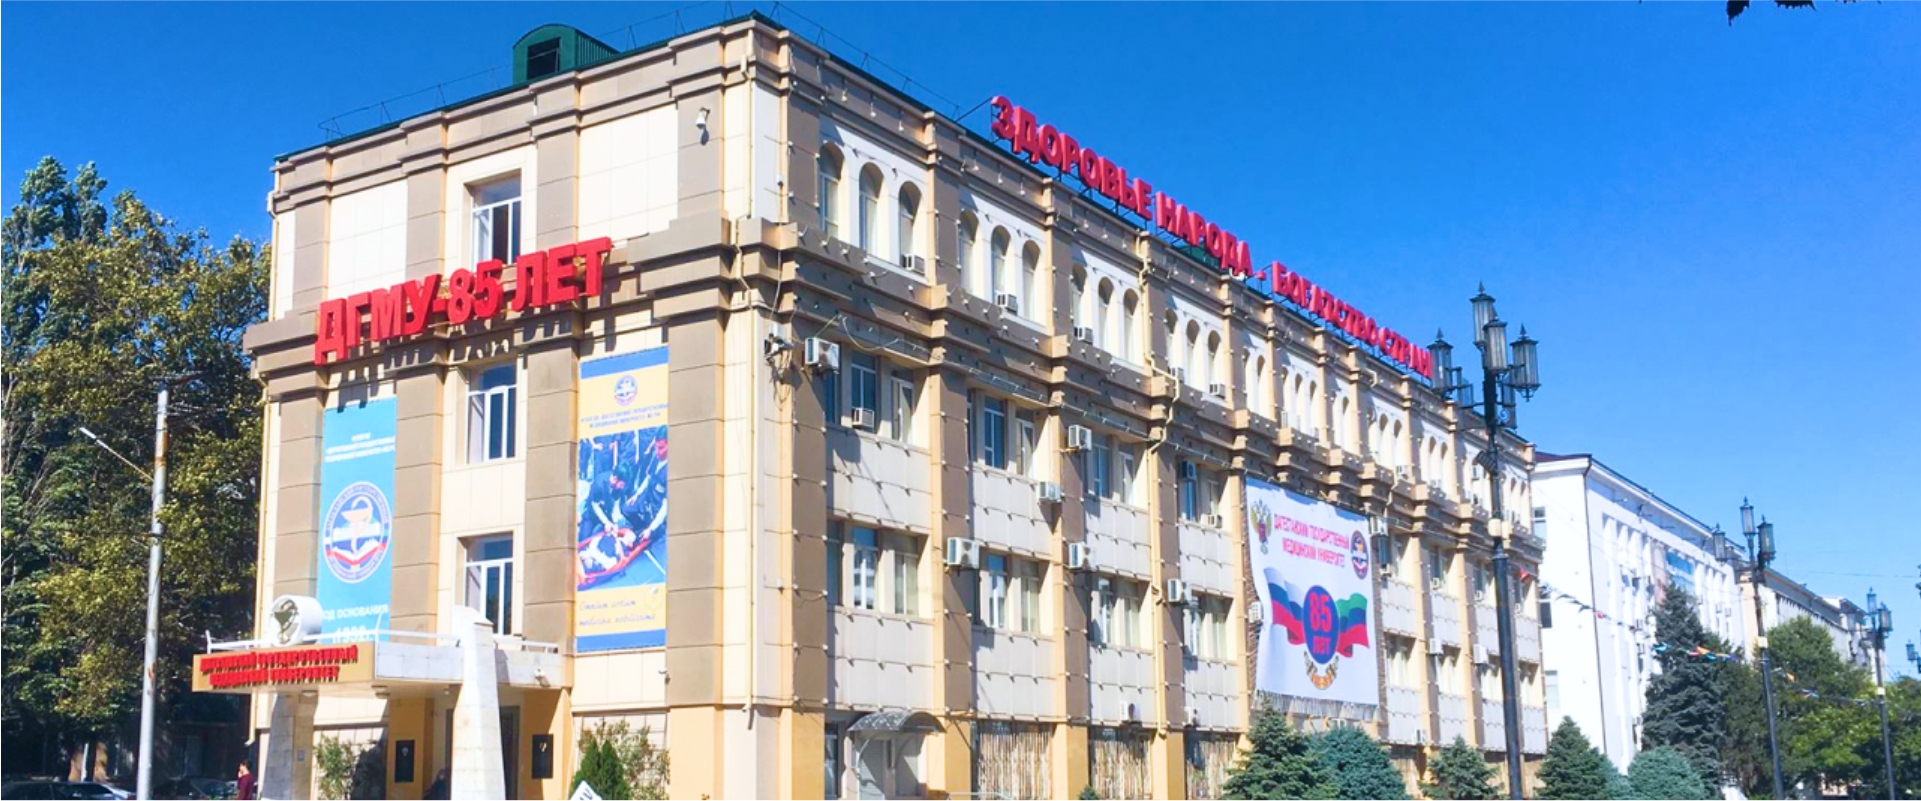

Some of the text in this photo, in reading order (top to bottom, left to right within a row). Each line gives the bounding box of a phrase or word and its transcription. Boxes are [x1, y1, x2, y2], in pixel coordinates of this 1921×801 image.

[991, 95, 1152, 221] ЗДОРОВЬЕ
[1155, 191, 1253, 277] НАРОДА
[1272, 261, 1379, 346] БОГАТСТВО
[1378, 327, 1433, 380] СТРАН
[512, 236, 612, 312] ЛЕТ
[336, 604, 389, 619] ОСНОВАНИЯ
[1309, 590, 1332, 632] 85
[1312, 635, 1332, 655] ЛЕТ
